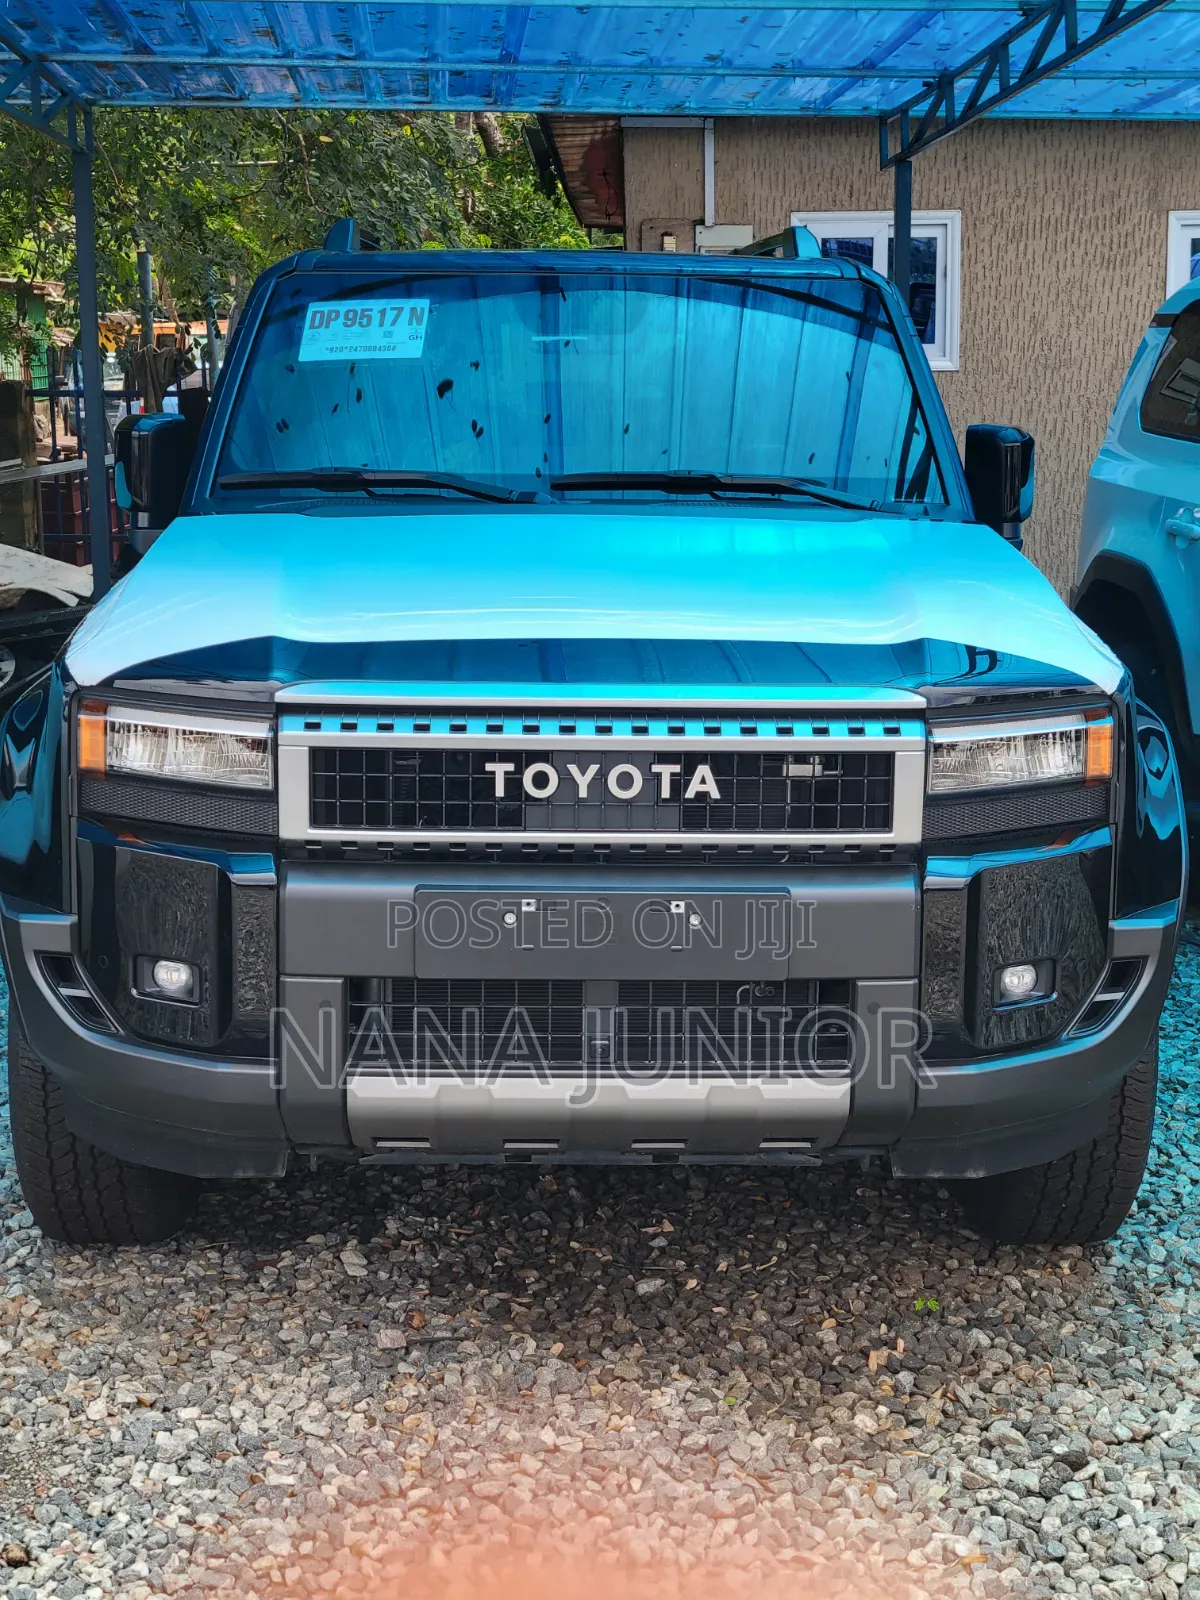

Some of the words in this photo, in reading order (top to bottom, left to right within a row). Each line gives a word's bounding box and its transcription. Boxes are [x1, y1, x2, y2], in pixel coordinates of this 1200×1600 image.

[308, 309, 341, 330] DP
[342, 307, 404, 328] 9517
[407, 306, 425, 326] N
[484, 762, 721, 800] TOYOTA
